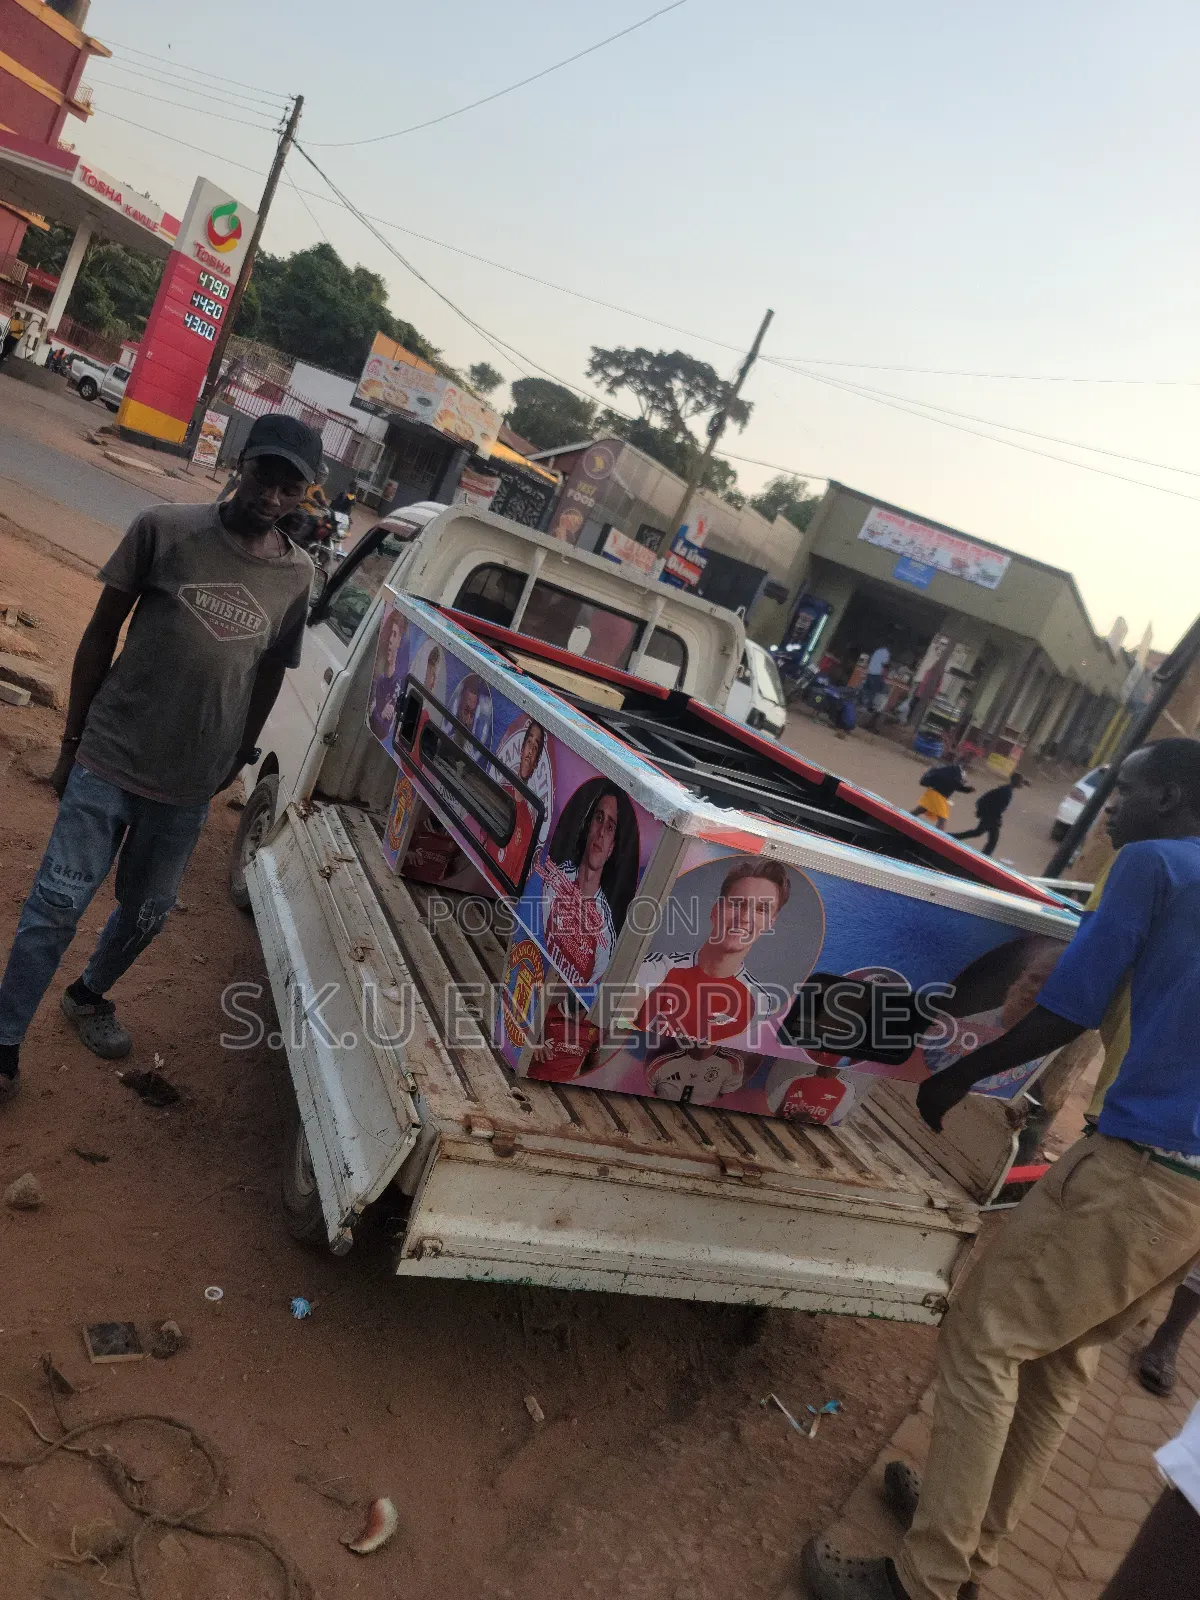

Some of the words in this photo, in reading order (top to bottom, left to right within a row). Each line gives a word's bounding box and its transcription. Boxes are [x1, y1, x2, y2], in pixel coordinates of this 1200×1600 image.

[80, 164, 124, 206] TOSHA
[194, 240, 232, 277] TOSHA
[199, 271, 231, 301] 4790
[192, 293, 224, 321] 4420
[183, 312, 217, 342] 4300
[566, 488, 596, 508] FOOD
[195, 590, 263, 631] WHISTLER
[209, 617, 240, 634] CANADA
[782, 1100, 830, 1118] Erates
